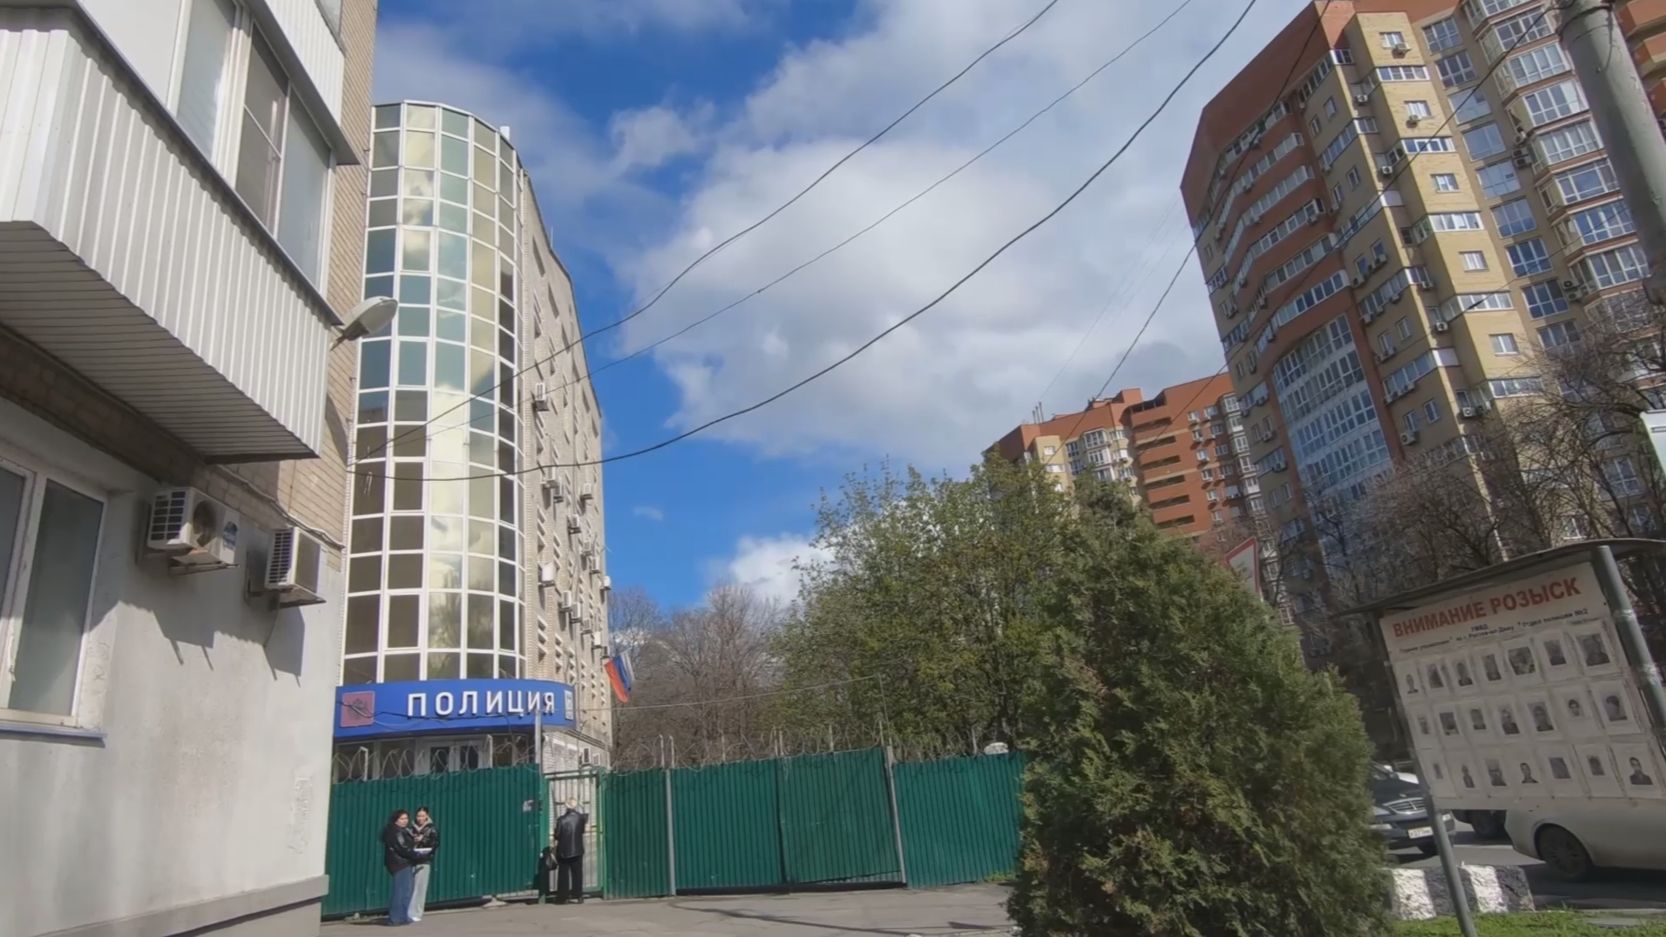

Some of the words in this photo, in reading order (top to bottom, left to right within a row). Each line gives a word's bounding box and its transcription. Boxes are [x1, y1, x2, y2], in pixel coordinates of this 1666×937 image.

[1392, 601, 1487, 638] ВНИМАНИЕ
[1490, 576, 1582, 615] РОЗЫСК
[407, 690, 555, 717] ПОЛИЦИЯ
